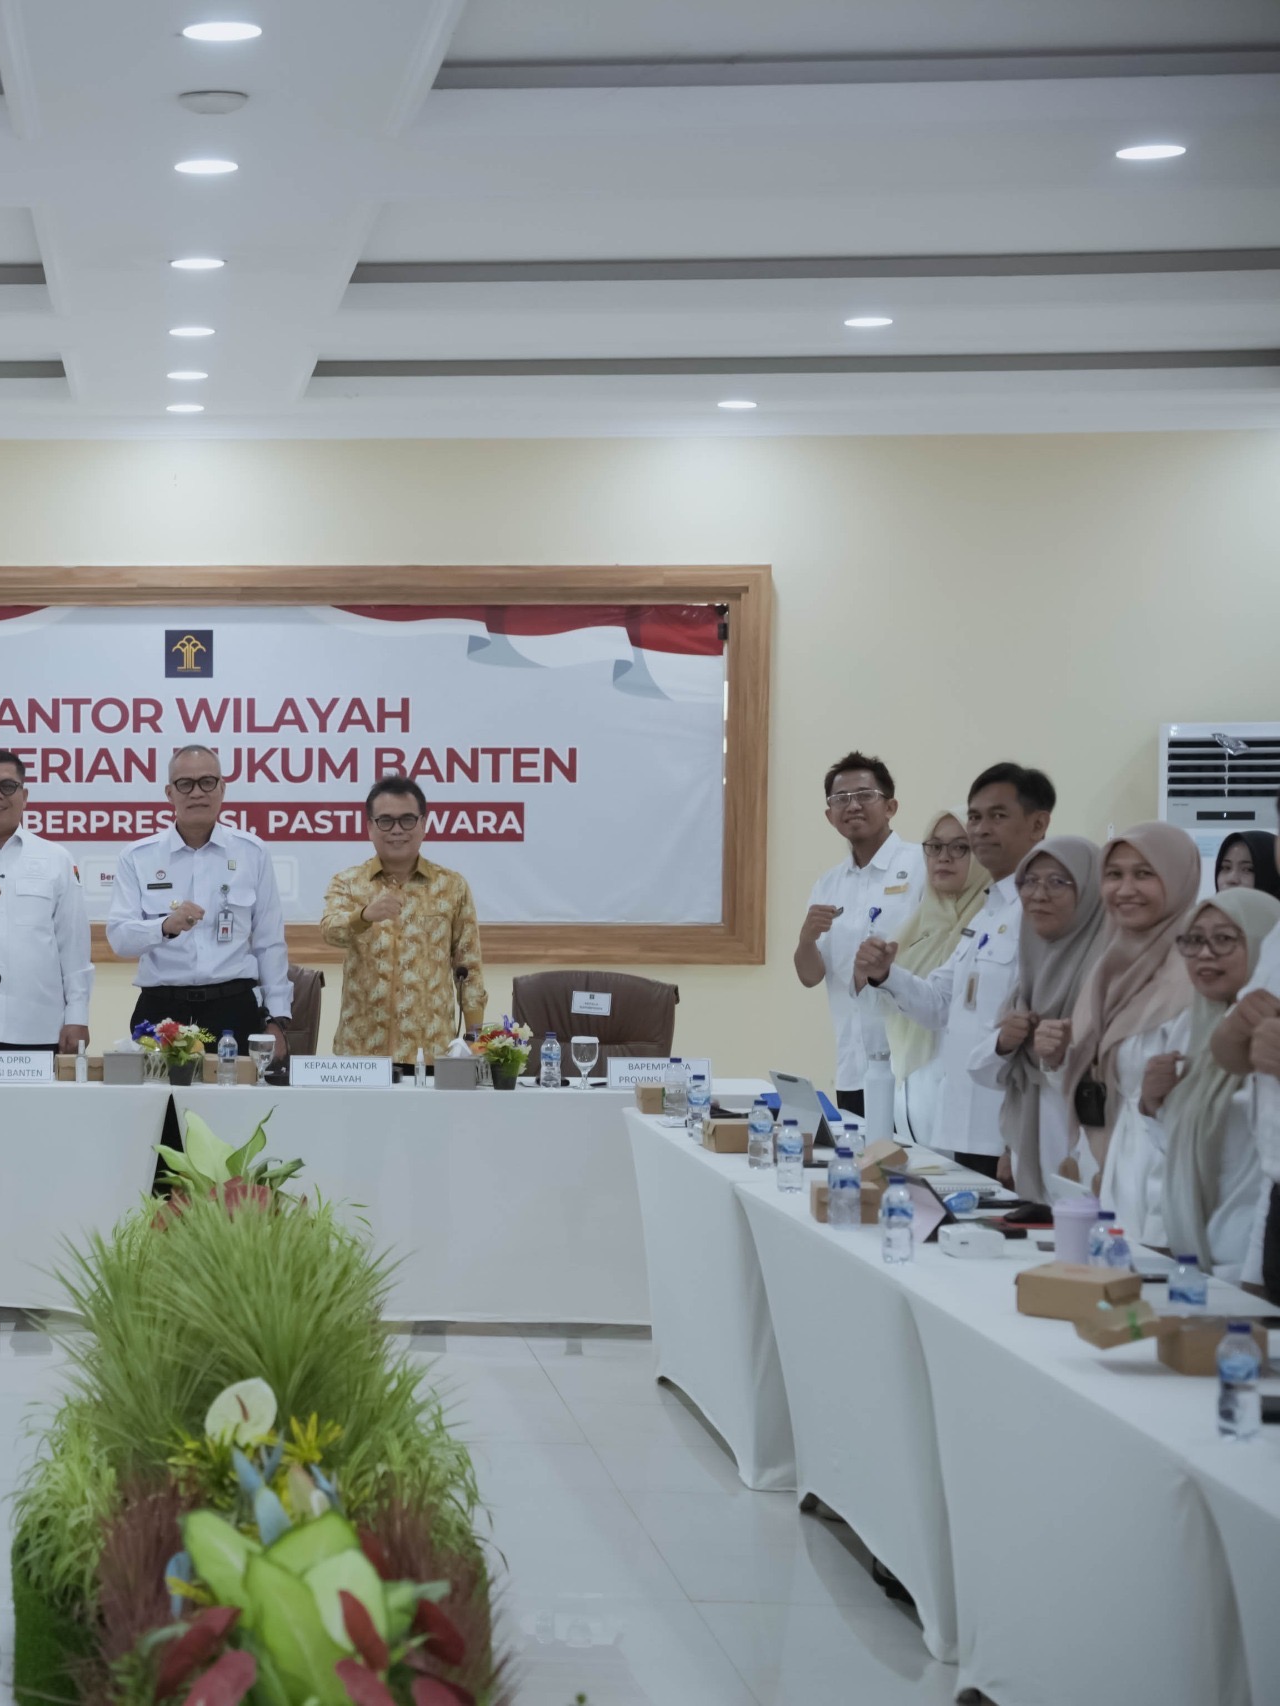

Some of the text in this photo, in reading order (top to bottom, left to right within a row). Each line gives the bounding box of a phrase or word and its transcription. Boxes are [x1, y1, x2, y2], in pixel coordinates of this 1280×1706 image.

[176, 697, 410, 734] WILAYAH
[173, 747, 358, 784] UKUM
[375, 747, 577, 783] BANTEN
[23, 810, 257, 835] BERPRESSI,
[268, 810, 362, 834] PASTI
[425, 810, 523, 834] WARA
[7, 1056, 31, 1064] DPRD
[304, 1062, 377, 1070] KEPALA KANTOR
[628, 1062, 691, 1071] BAPEMPEA
[7, 1068, 43, 1077] BANTEN
[320, 1075, 362, 1083] WILAYAH
[619, 1075, 662, 1084] PROVINSI
